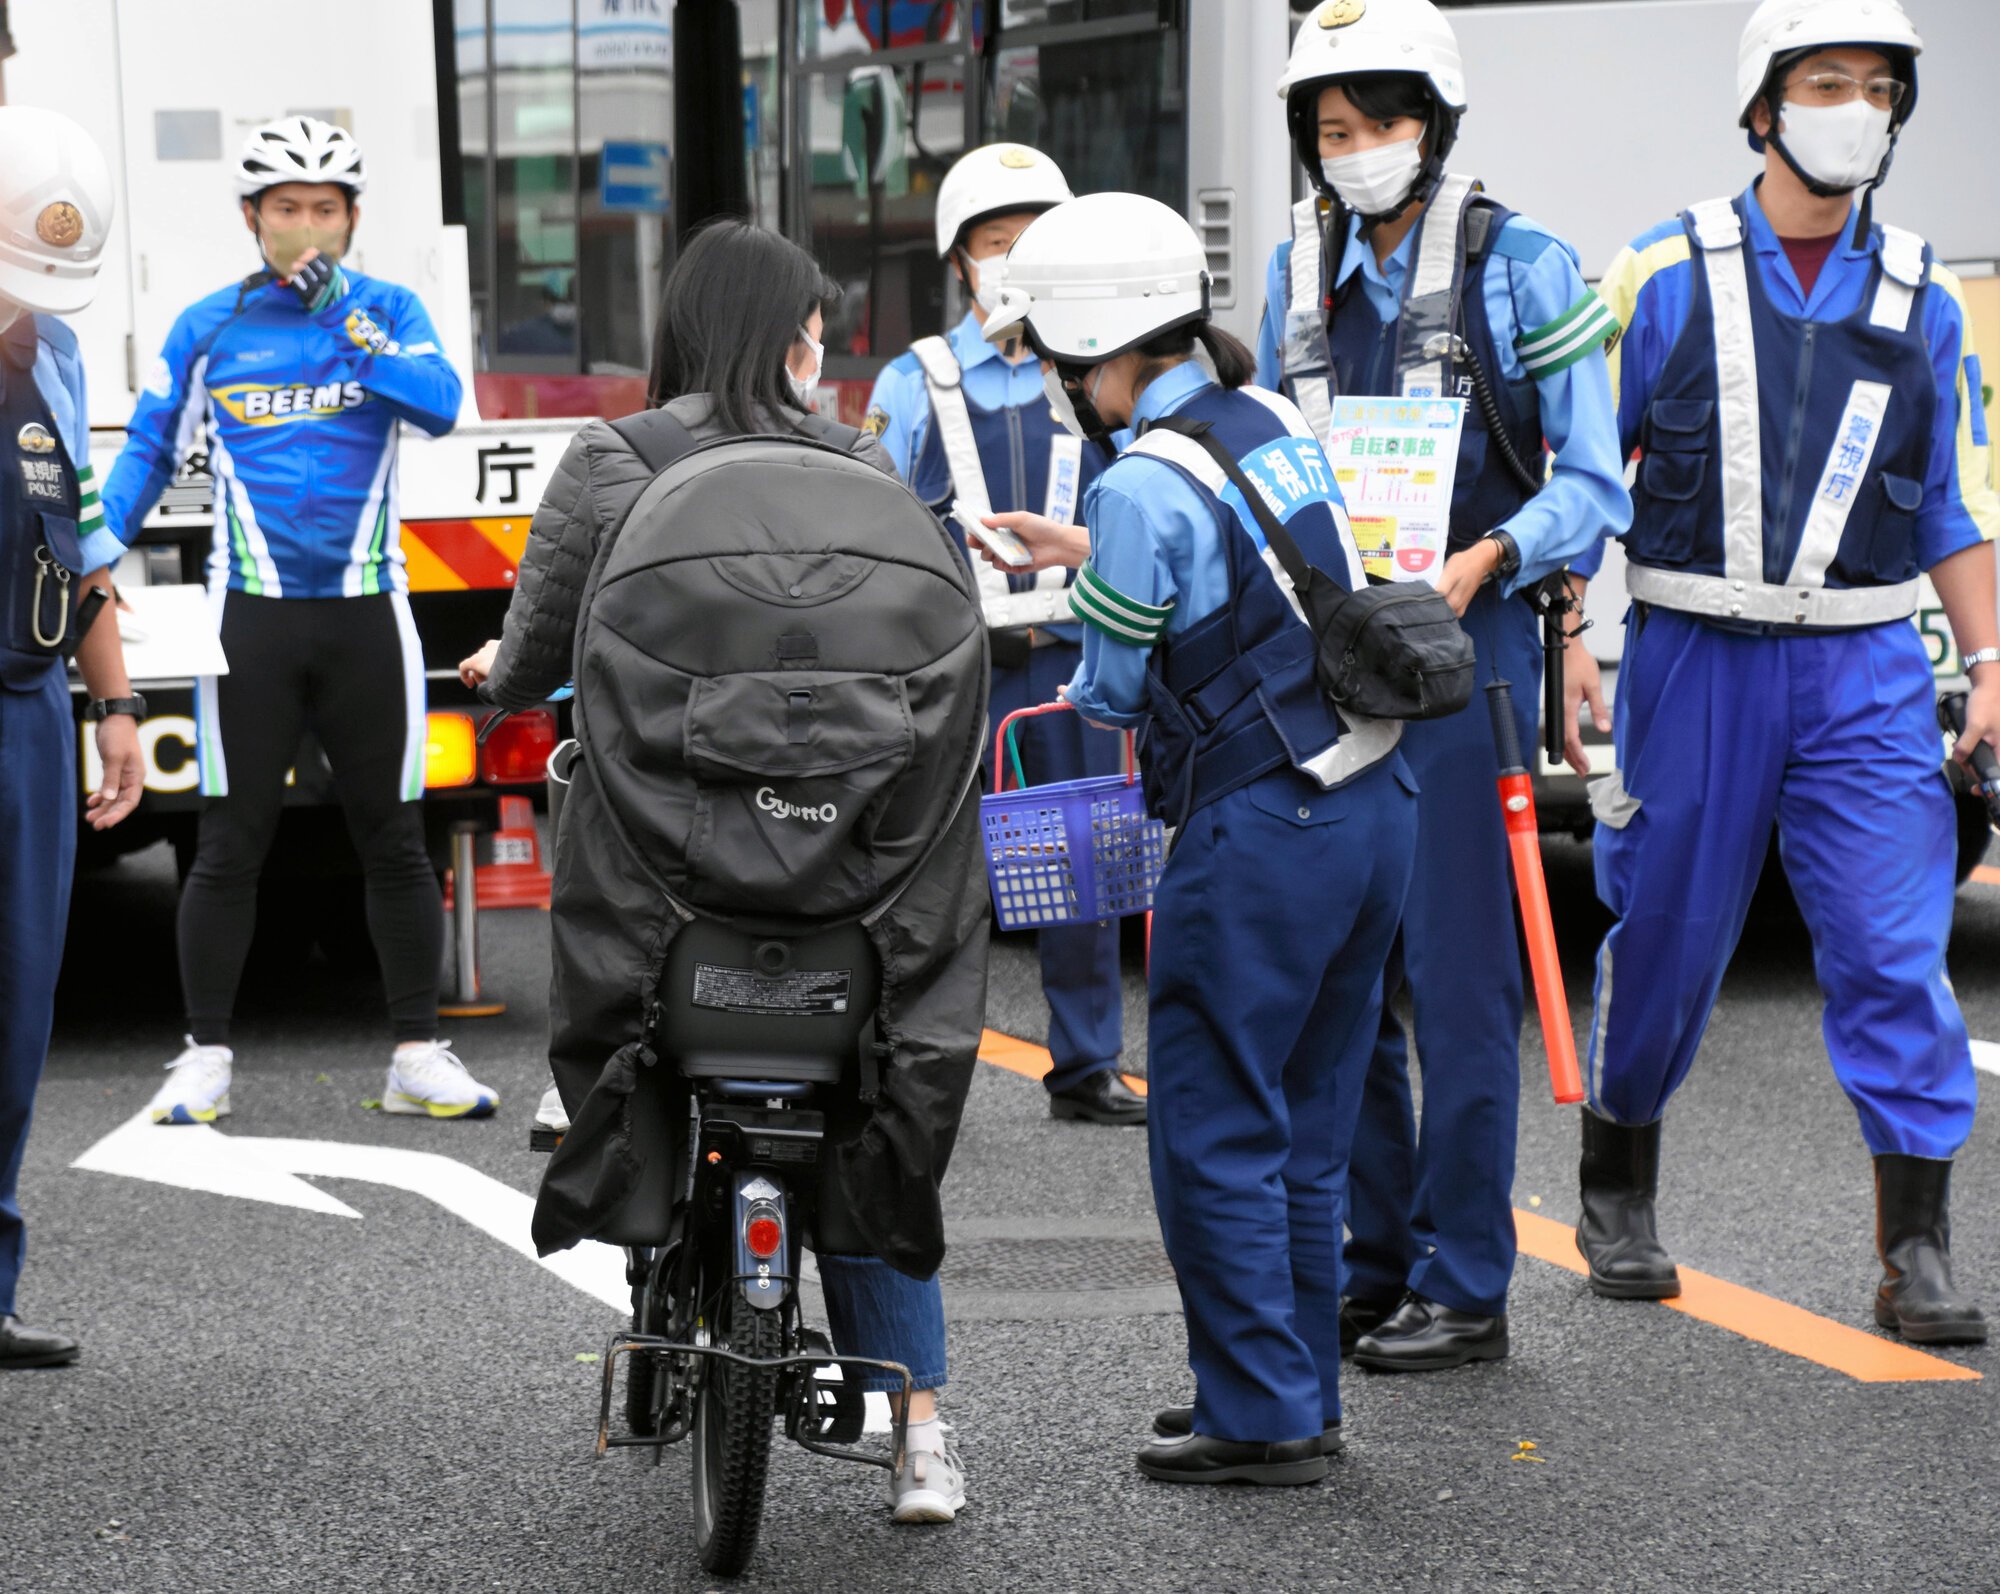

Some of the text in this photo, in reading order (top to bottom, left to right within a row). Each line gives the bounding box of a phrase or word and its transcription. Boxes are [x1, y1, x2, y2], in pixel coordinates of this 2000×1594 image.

[244, 380, 366, 419] BEEMS
[1350, 436, 1436, 457] 自転車事故
[1826, 413, 1873, 499] 警視庁
[28, 482, 62, 499] POLICE
[475, 442, 535, 503] 庁
